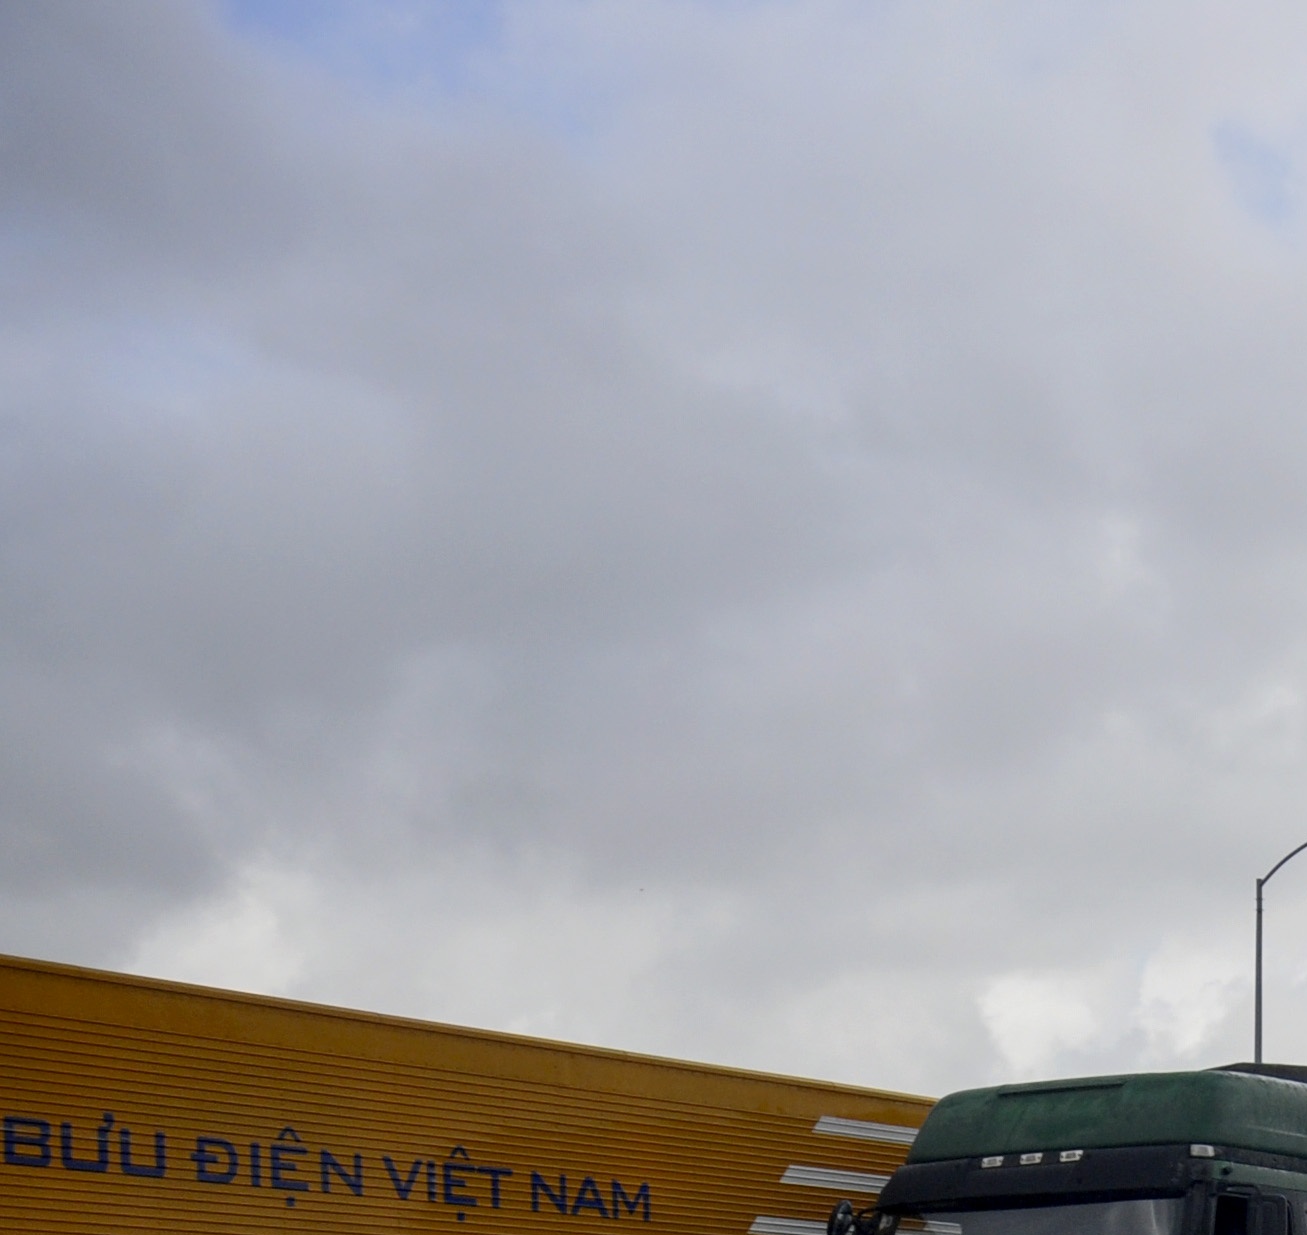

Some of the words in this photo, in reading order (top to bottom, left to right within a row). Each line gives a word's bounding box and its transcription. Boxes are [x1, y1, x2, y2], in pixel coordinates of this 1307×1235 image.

[3, 1112, 166, 1178] BƯU
[190, 1126, 363, 1207] ĐIỆN
[382, 1144, 513, 1222] VIỆT
[530, 1170, 651, 1222] NAM
